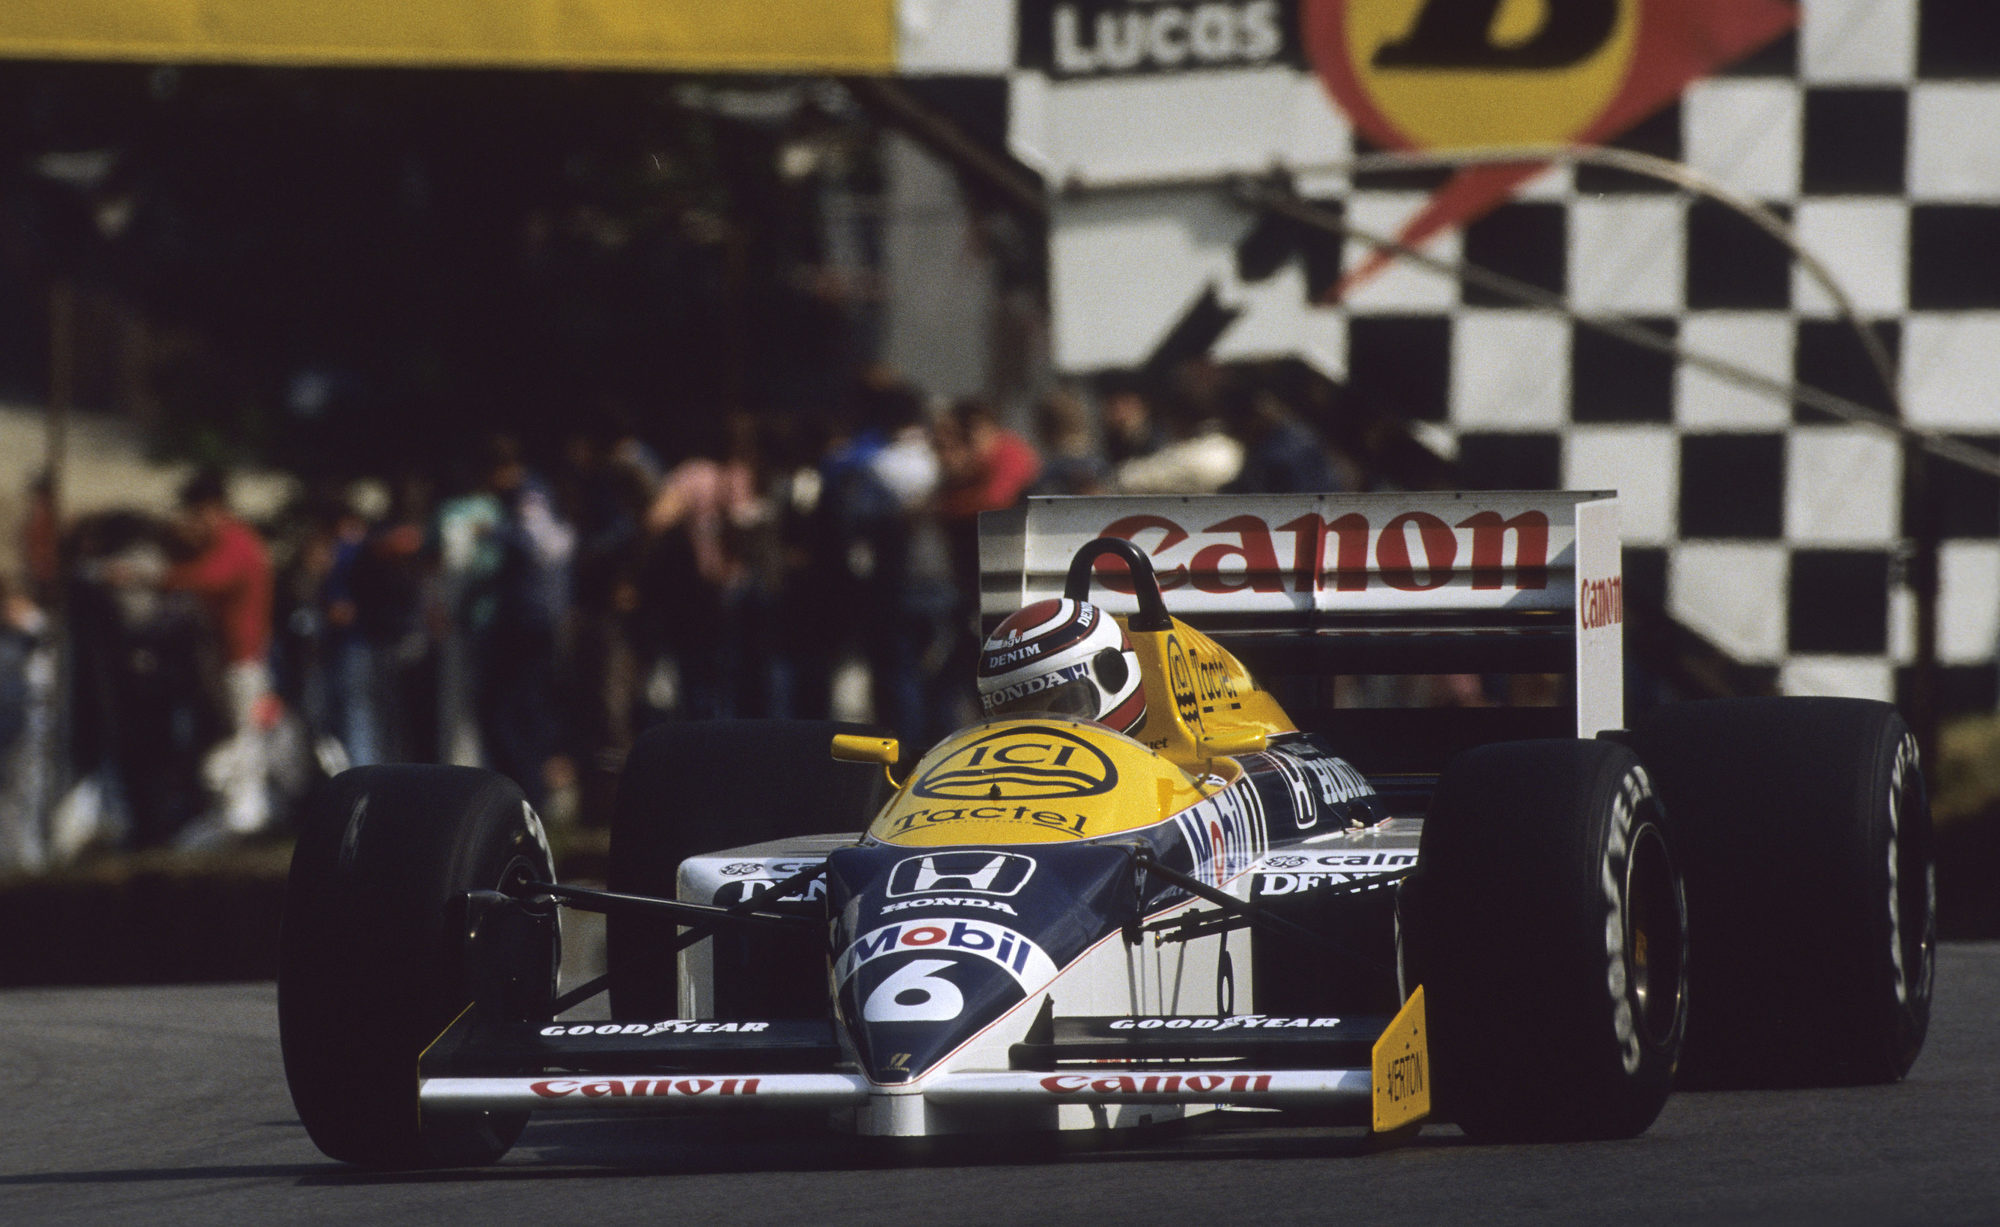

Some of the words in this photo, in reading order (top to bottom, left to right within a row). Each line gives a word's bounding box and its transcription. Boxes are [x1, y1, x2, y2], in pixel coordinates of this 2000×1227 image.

[1093, 509, 1551, 595] Canon
[989, 642, 1041, 669] DENIM
[981, 671, 1068, 710] HONDA
[966, 744, 1077, 767] ICI
[895, 805, 1089, 835] Tactel
[880, 897, 1018, 916] HONDA
[846, 922, 1032, 978] Mobil
[863, 959, 964, 1022] 6
[540, 1019, 769, 1037] GOODYEAR
[1109, 1014, 1341, 1031] GOODYEAR
[529, 1078, 761, 1099] Canon
[1039, 1074, 1272, 1094] Canon
